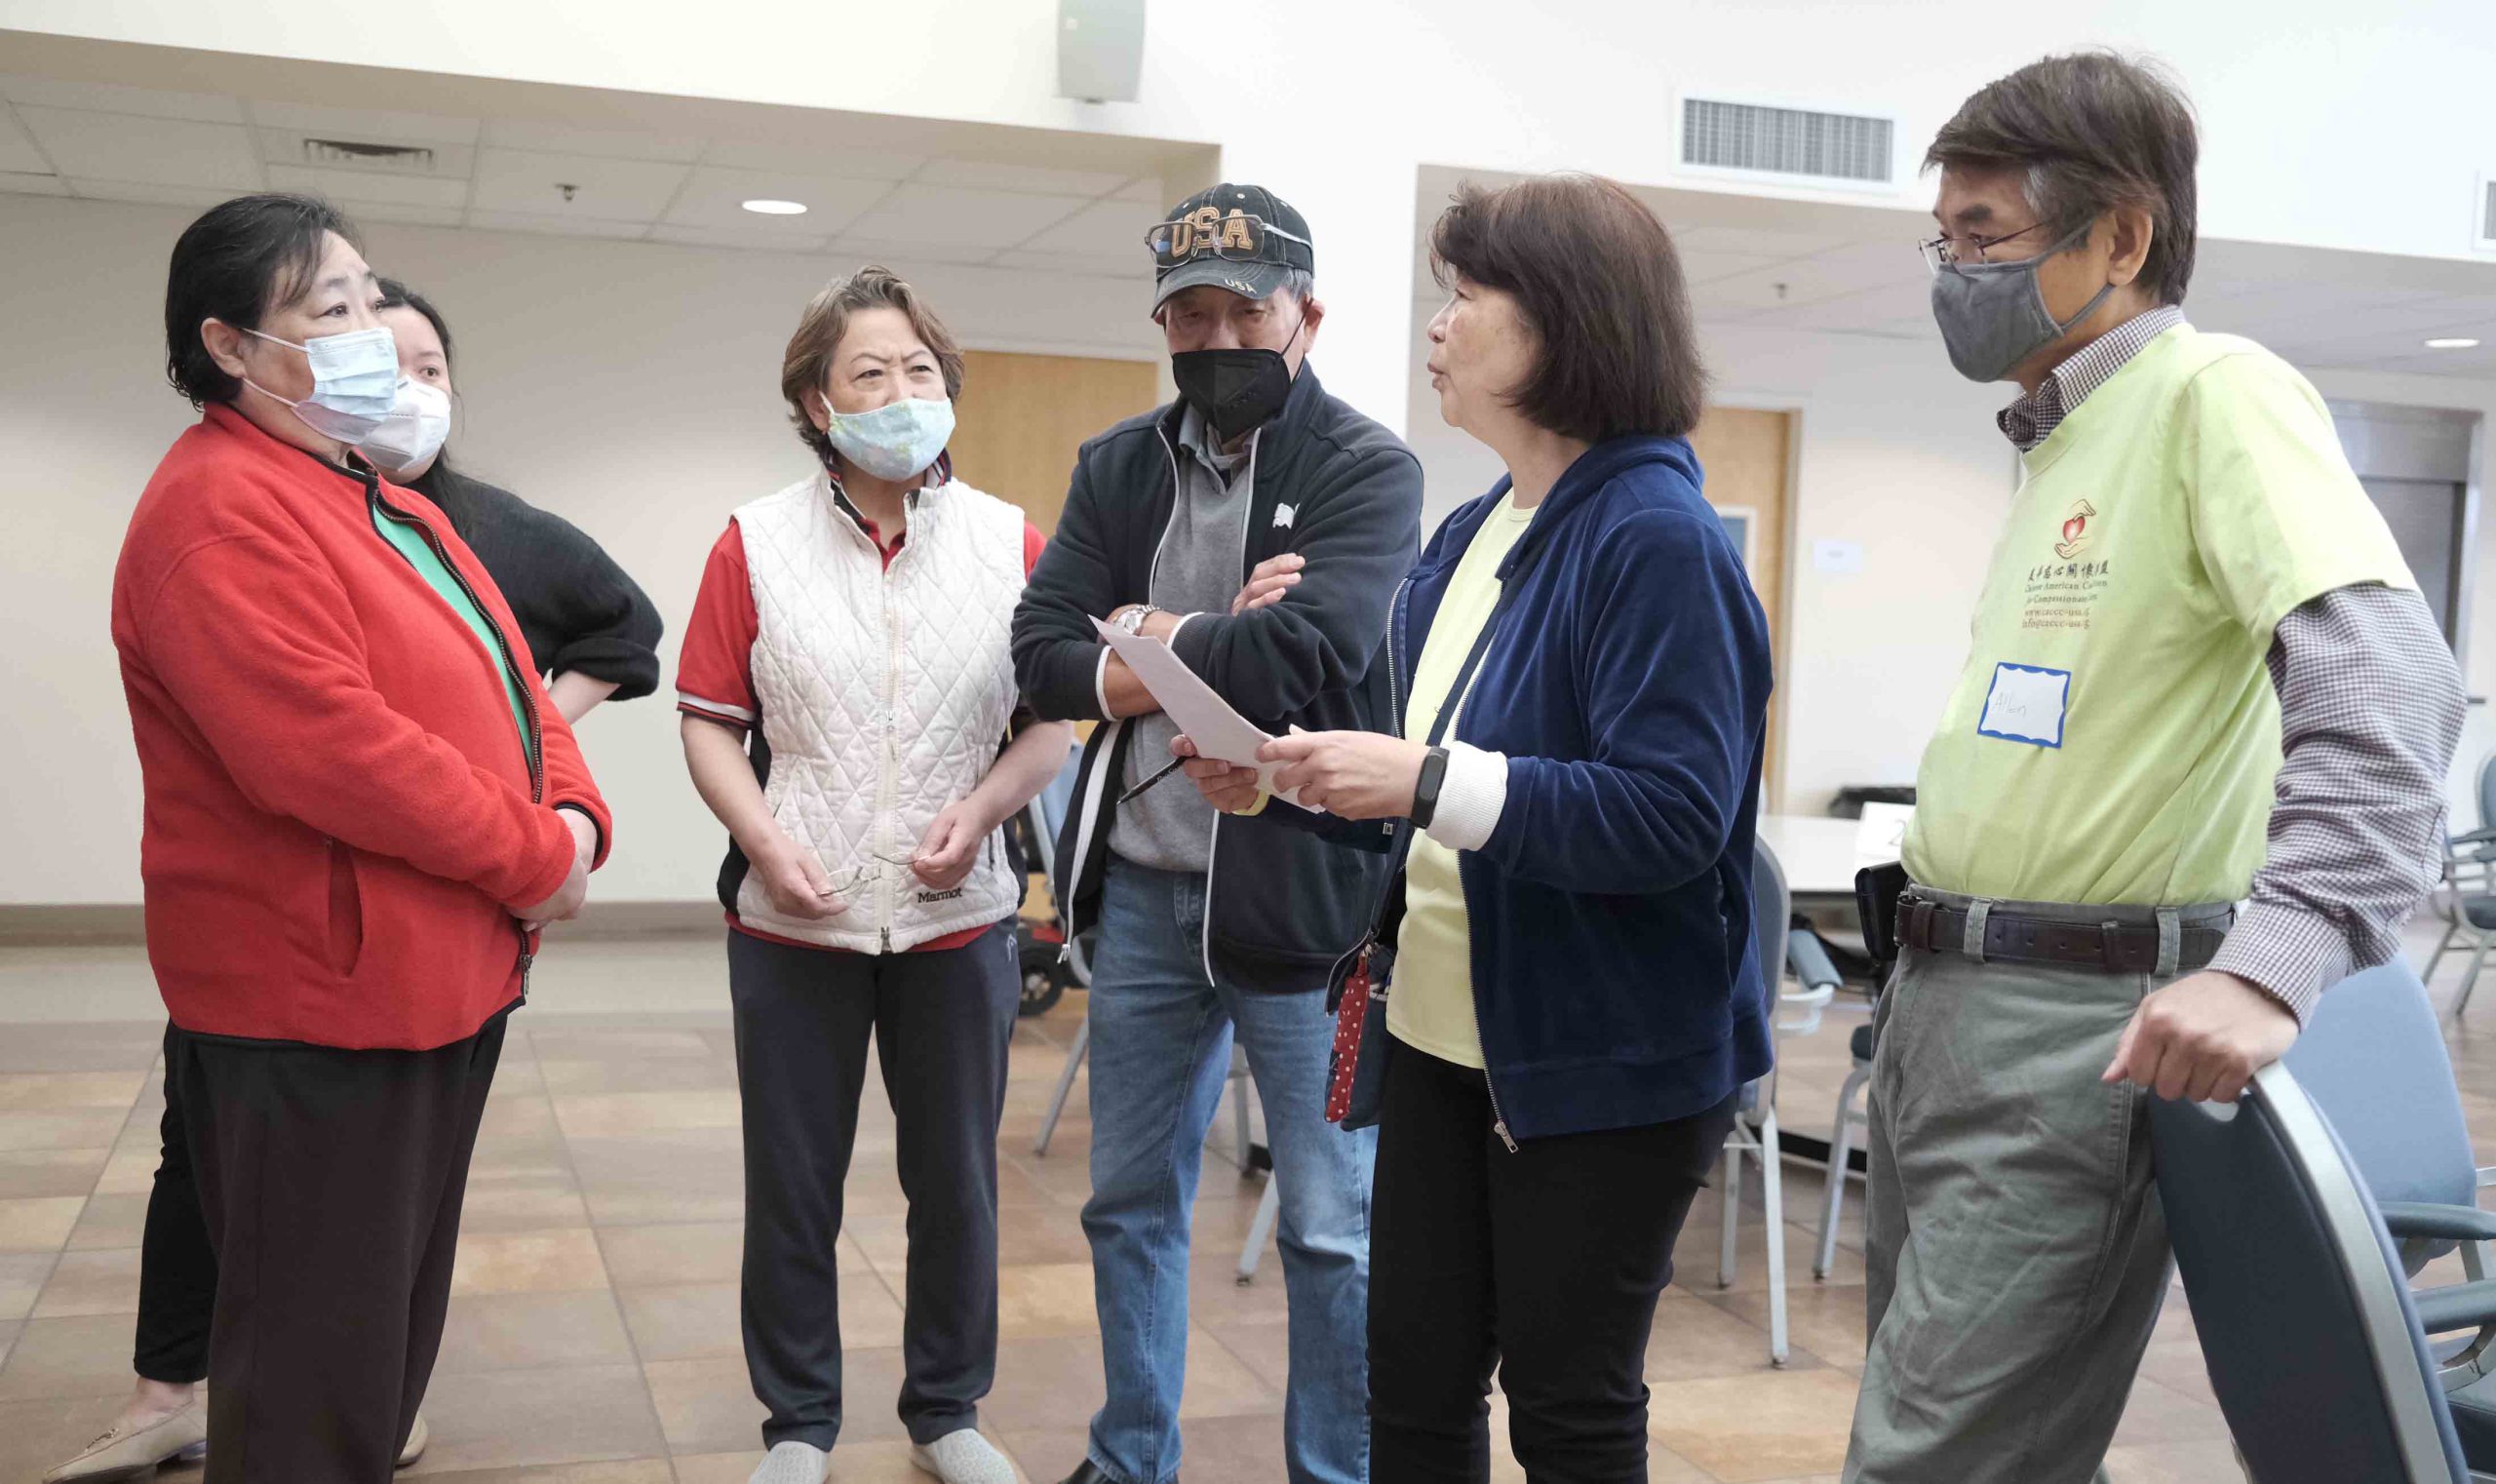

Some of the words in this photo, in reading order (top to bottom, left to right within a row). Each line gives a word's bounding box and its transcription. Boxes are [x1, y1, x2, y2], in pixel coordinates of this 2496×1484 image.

[1171, 206, 1253, 257] USA
[1224, 278, 1258, 294] USA
[917, 886, 962, 904] Marmot
